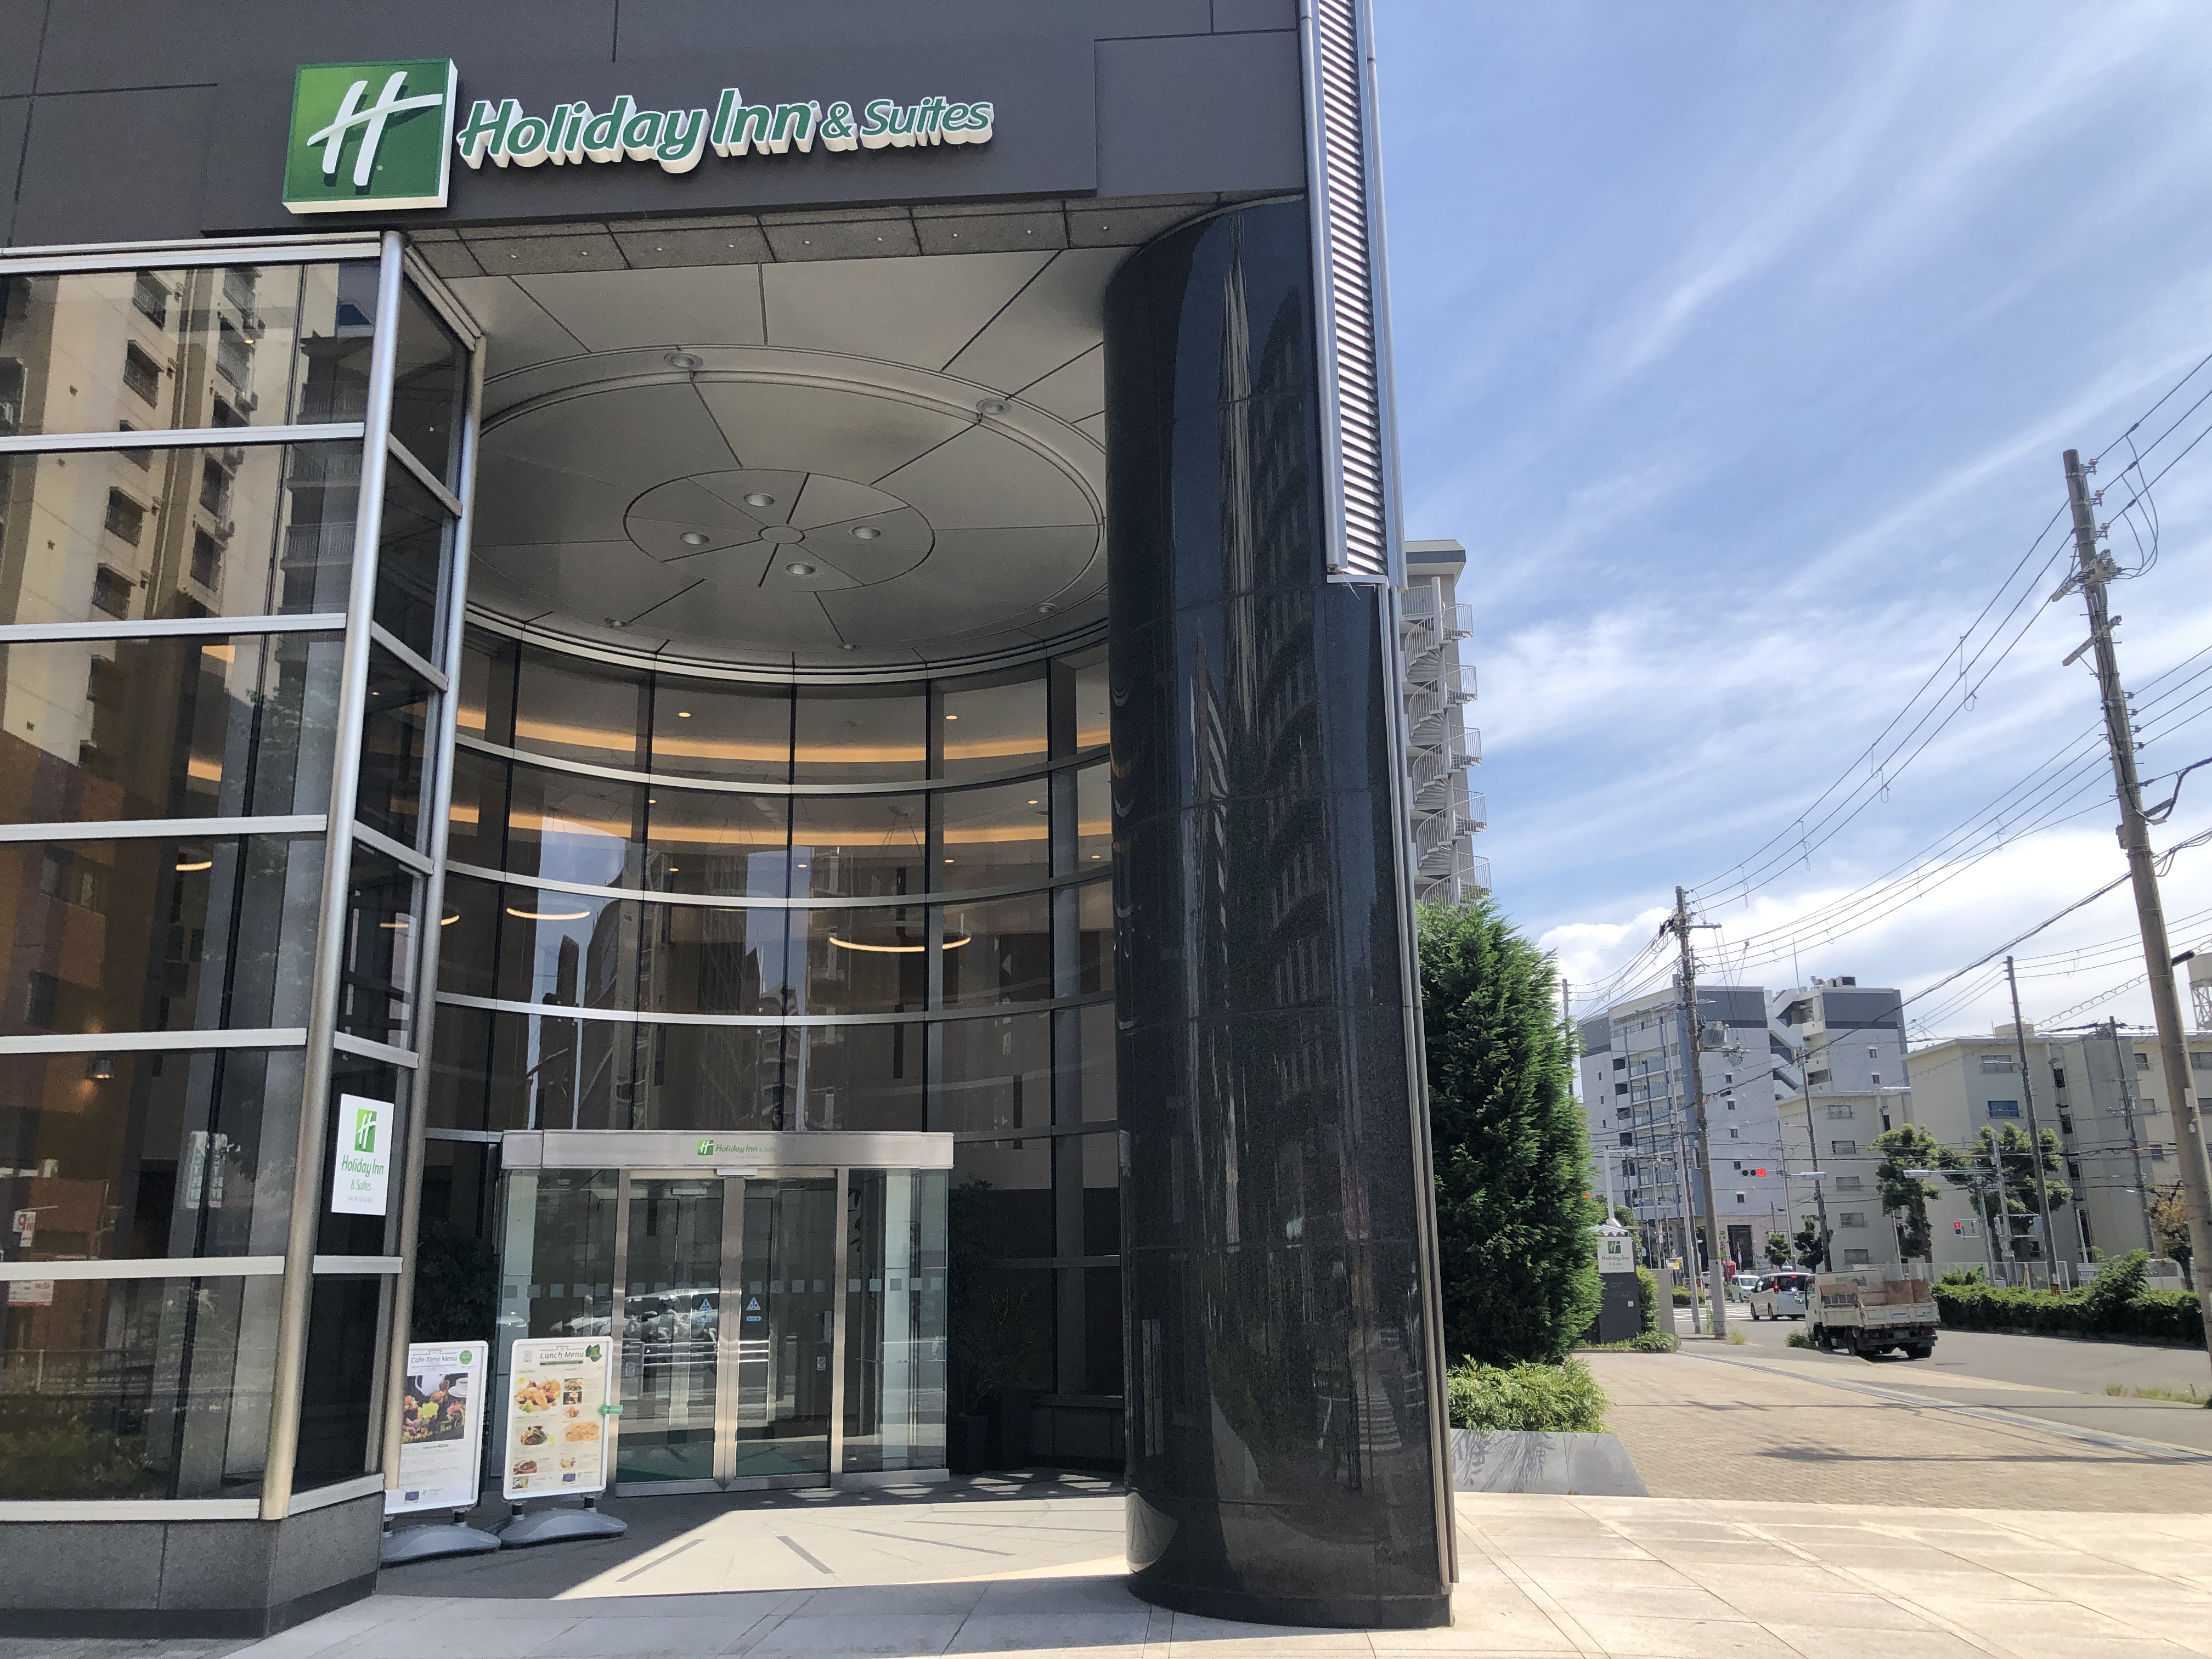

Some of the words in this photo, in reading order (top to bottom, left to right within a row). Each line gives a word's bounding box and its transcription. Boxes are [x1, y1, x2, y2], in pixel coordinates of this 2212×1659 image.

[456, 94, 709, 167] Holiday
[712, 88, 812, 151] Inn
[821, 101, 857, 145] &
[859, 96, 994, 140] Suites
[715, 1144, 745, 1154] Holiday
[341, 1154, 371, 1178] Holiday
[372, 1158, 385, 1176] Inn
[351, 1179, 355, 1189] &
[540, 1351, 562, 1359] Lunch
